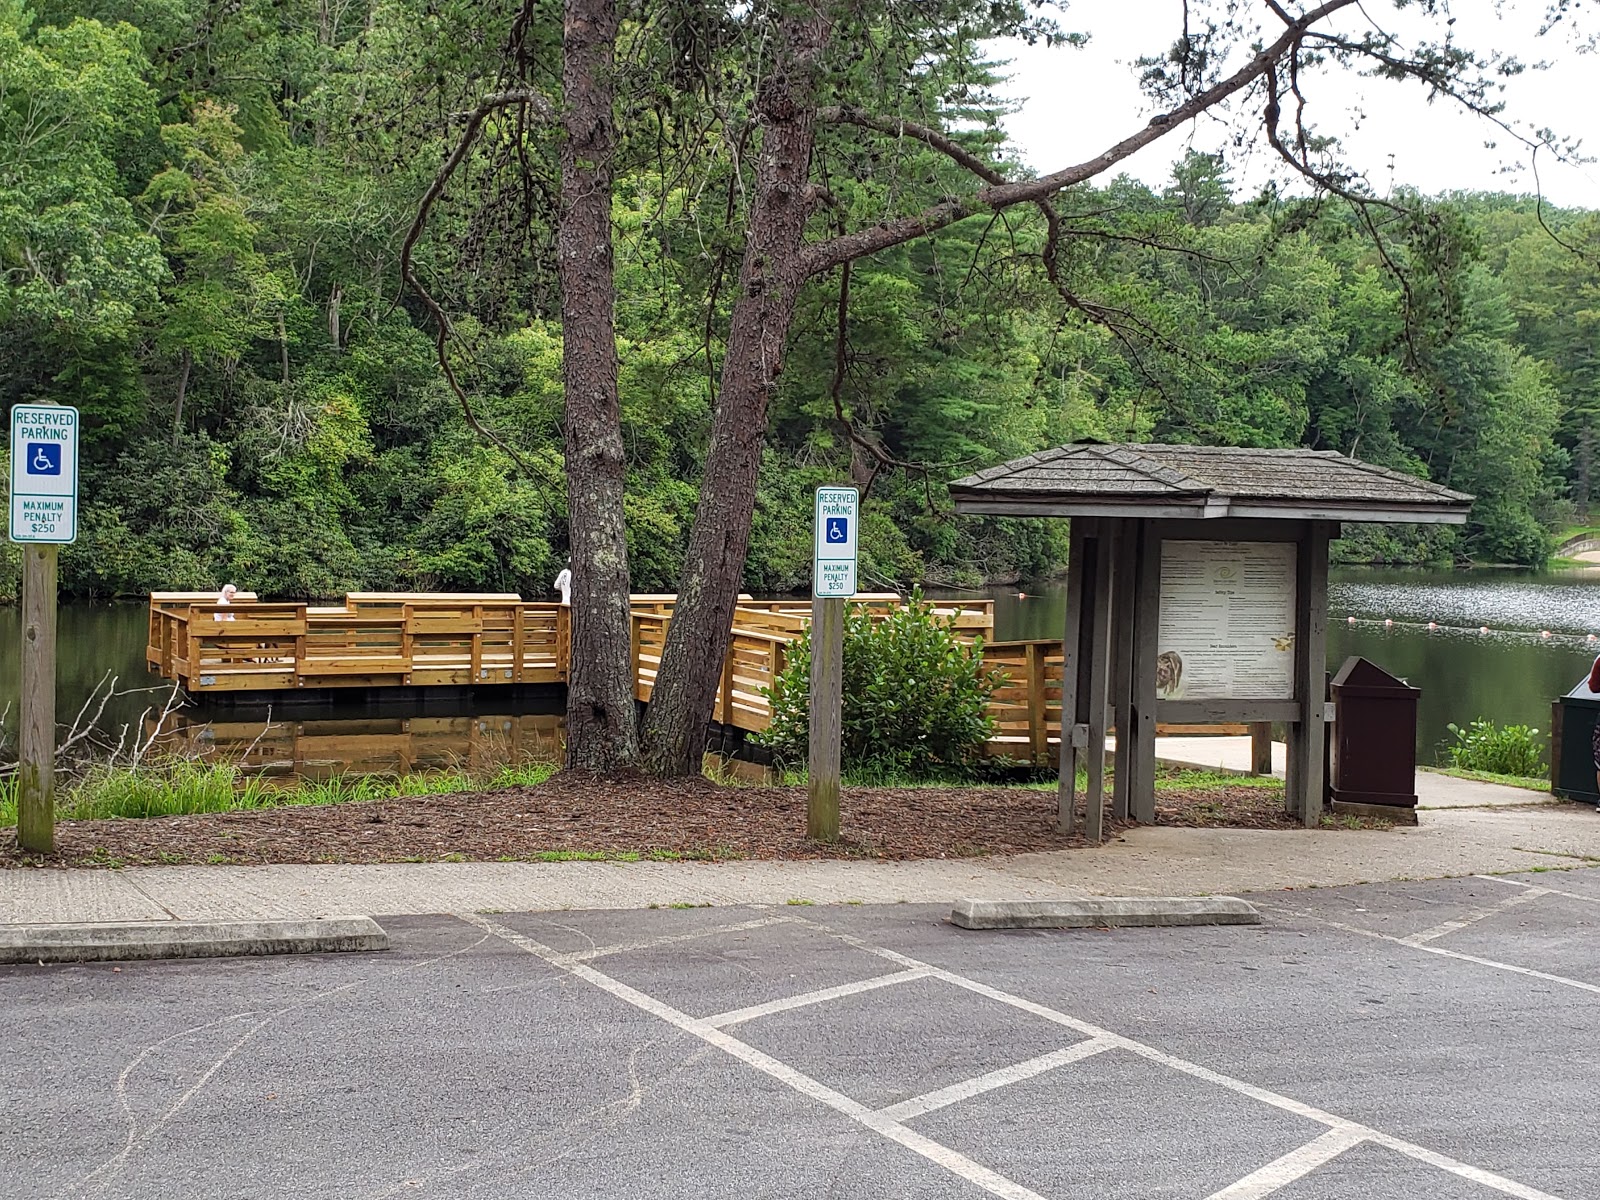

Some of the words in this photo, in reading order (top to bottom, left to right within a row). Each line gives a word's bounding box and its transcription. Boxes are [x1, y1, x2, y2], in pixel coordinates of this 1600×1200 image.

[16, 412, 74, 426] RESERVED
[21, 427, 68, 440] PARKING
[819, 493, 856, 503] RESERVED
[23, 501, 64, 511] MAXIMUM
[822, 505, 852, 515] PARKING
[23, 512, 62, 522] PENALTY
[31, 523, 55, 533] $250
[823, 573, 848, 581] PENALTY
[828, 582, 844, 590] $250
